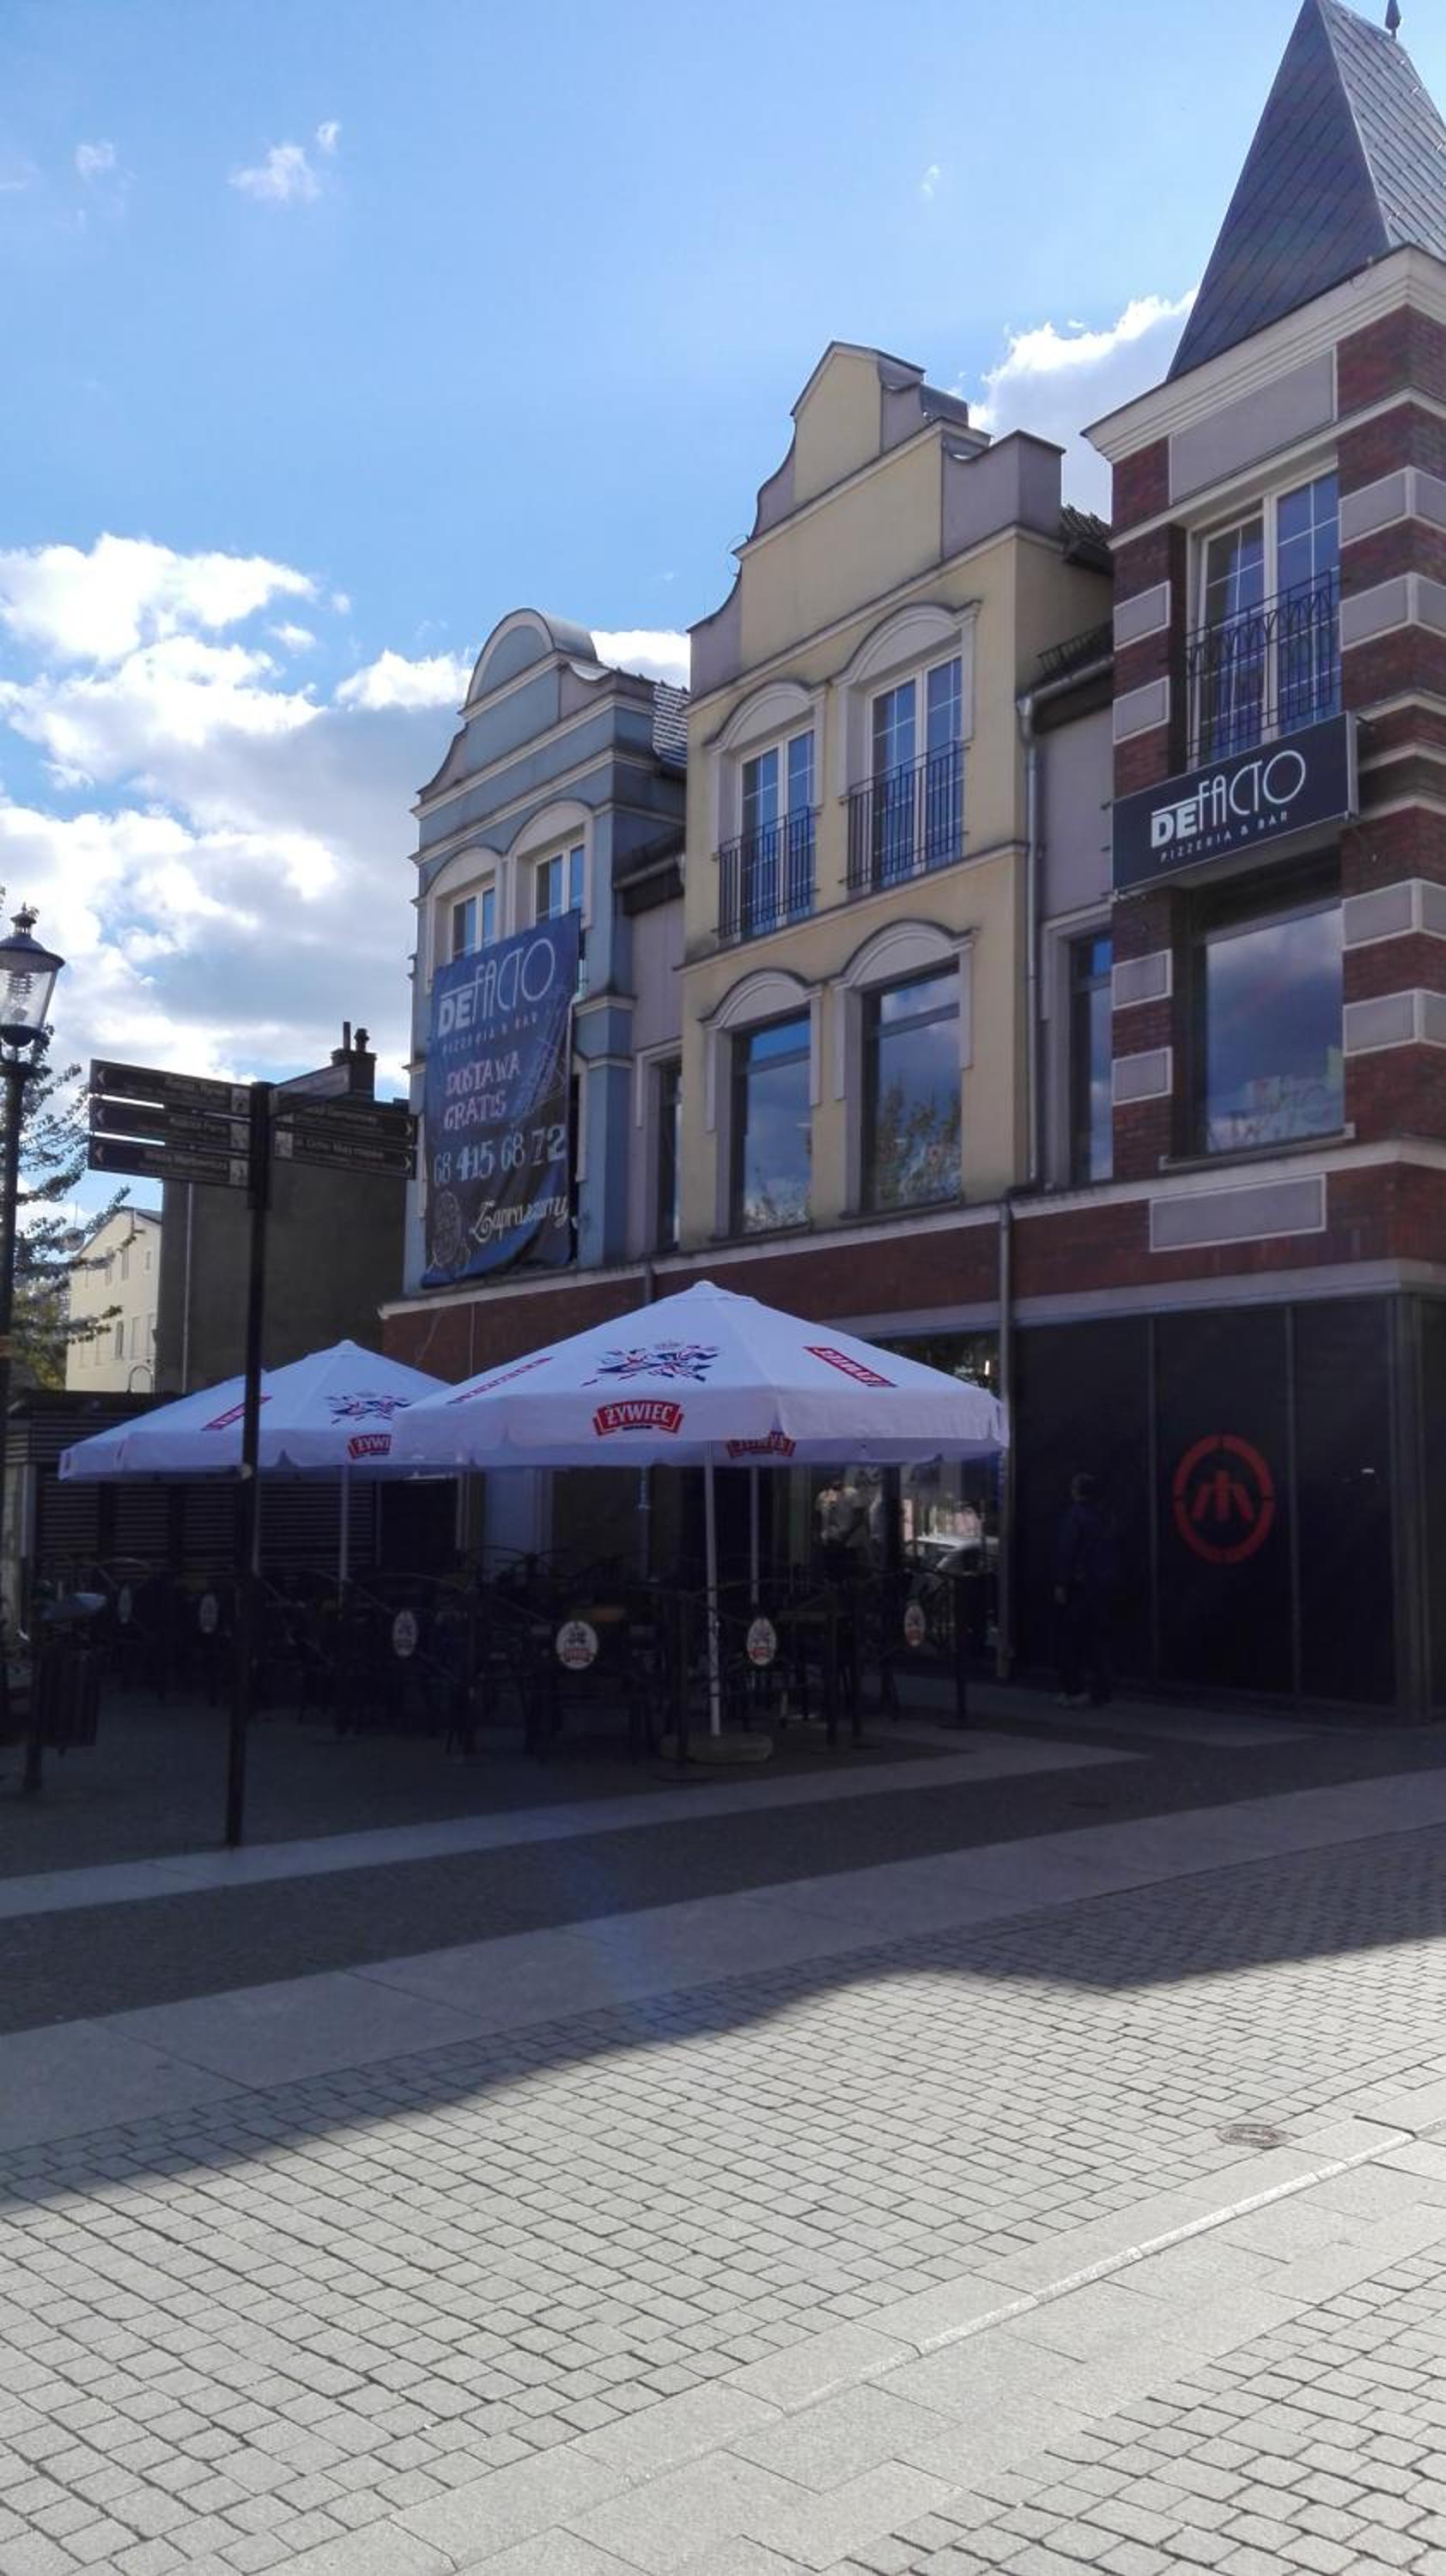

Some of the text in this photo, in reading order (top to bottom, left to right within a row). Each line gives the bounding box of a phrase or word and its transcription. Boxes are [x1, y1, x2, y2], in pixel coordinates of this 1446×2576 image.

[1151, 749, 1306, 849] DEFACTO
[1161, 811, 1287, 862] PIZZERIA & BAR
[438, 938, 556, 1038] DEFACTO
[446, 1051, 520, 1097] DOSTAWA
[444, 1090, 507, 1130] GRATIS
[456, 1140, 495, 1182] 415
[501, 1132, 526, 1172] 68
[531, 1123, 567, 1166] 72
[604, 1403, 674, 1425] ŻYWIEC
[357, 1437, 391, 1453] ŻYWI
